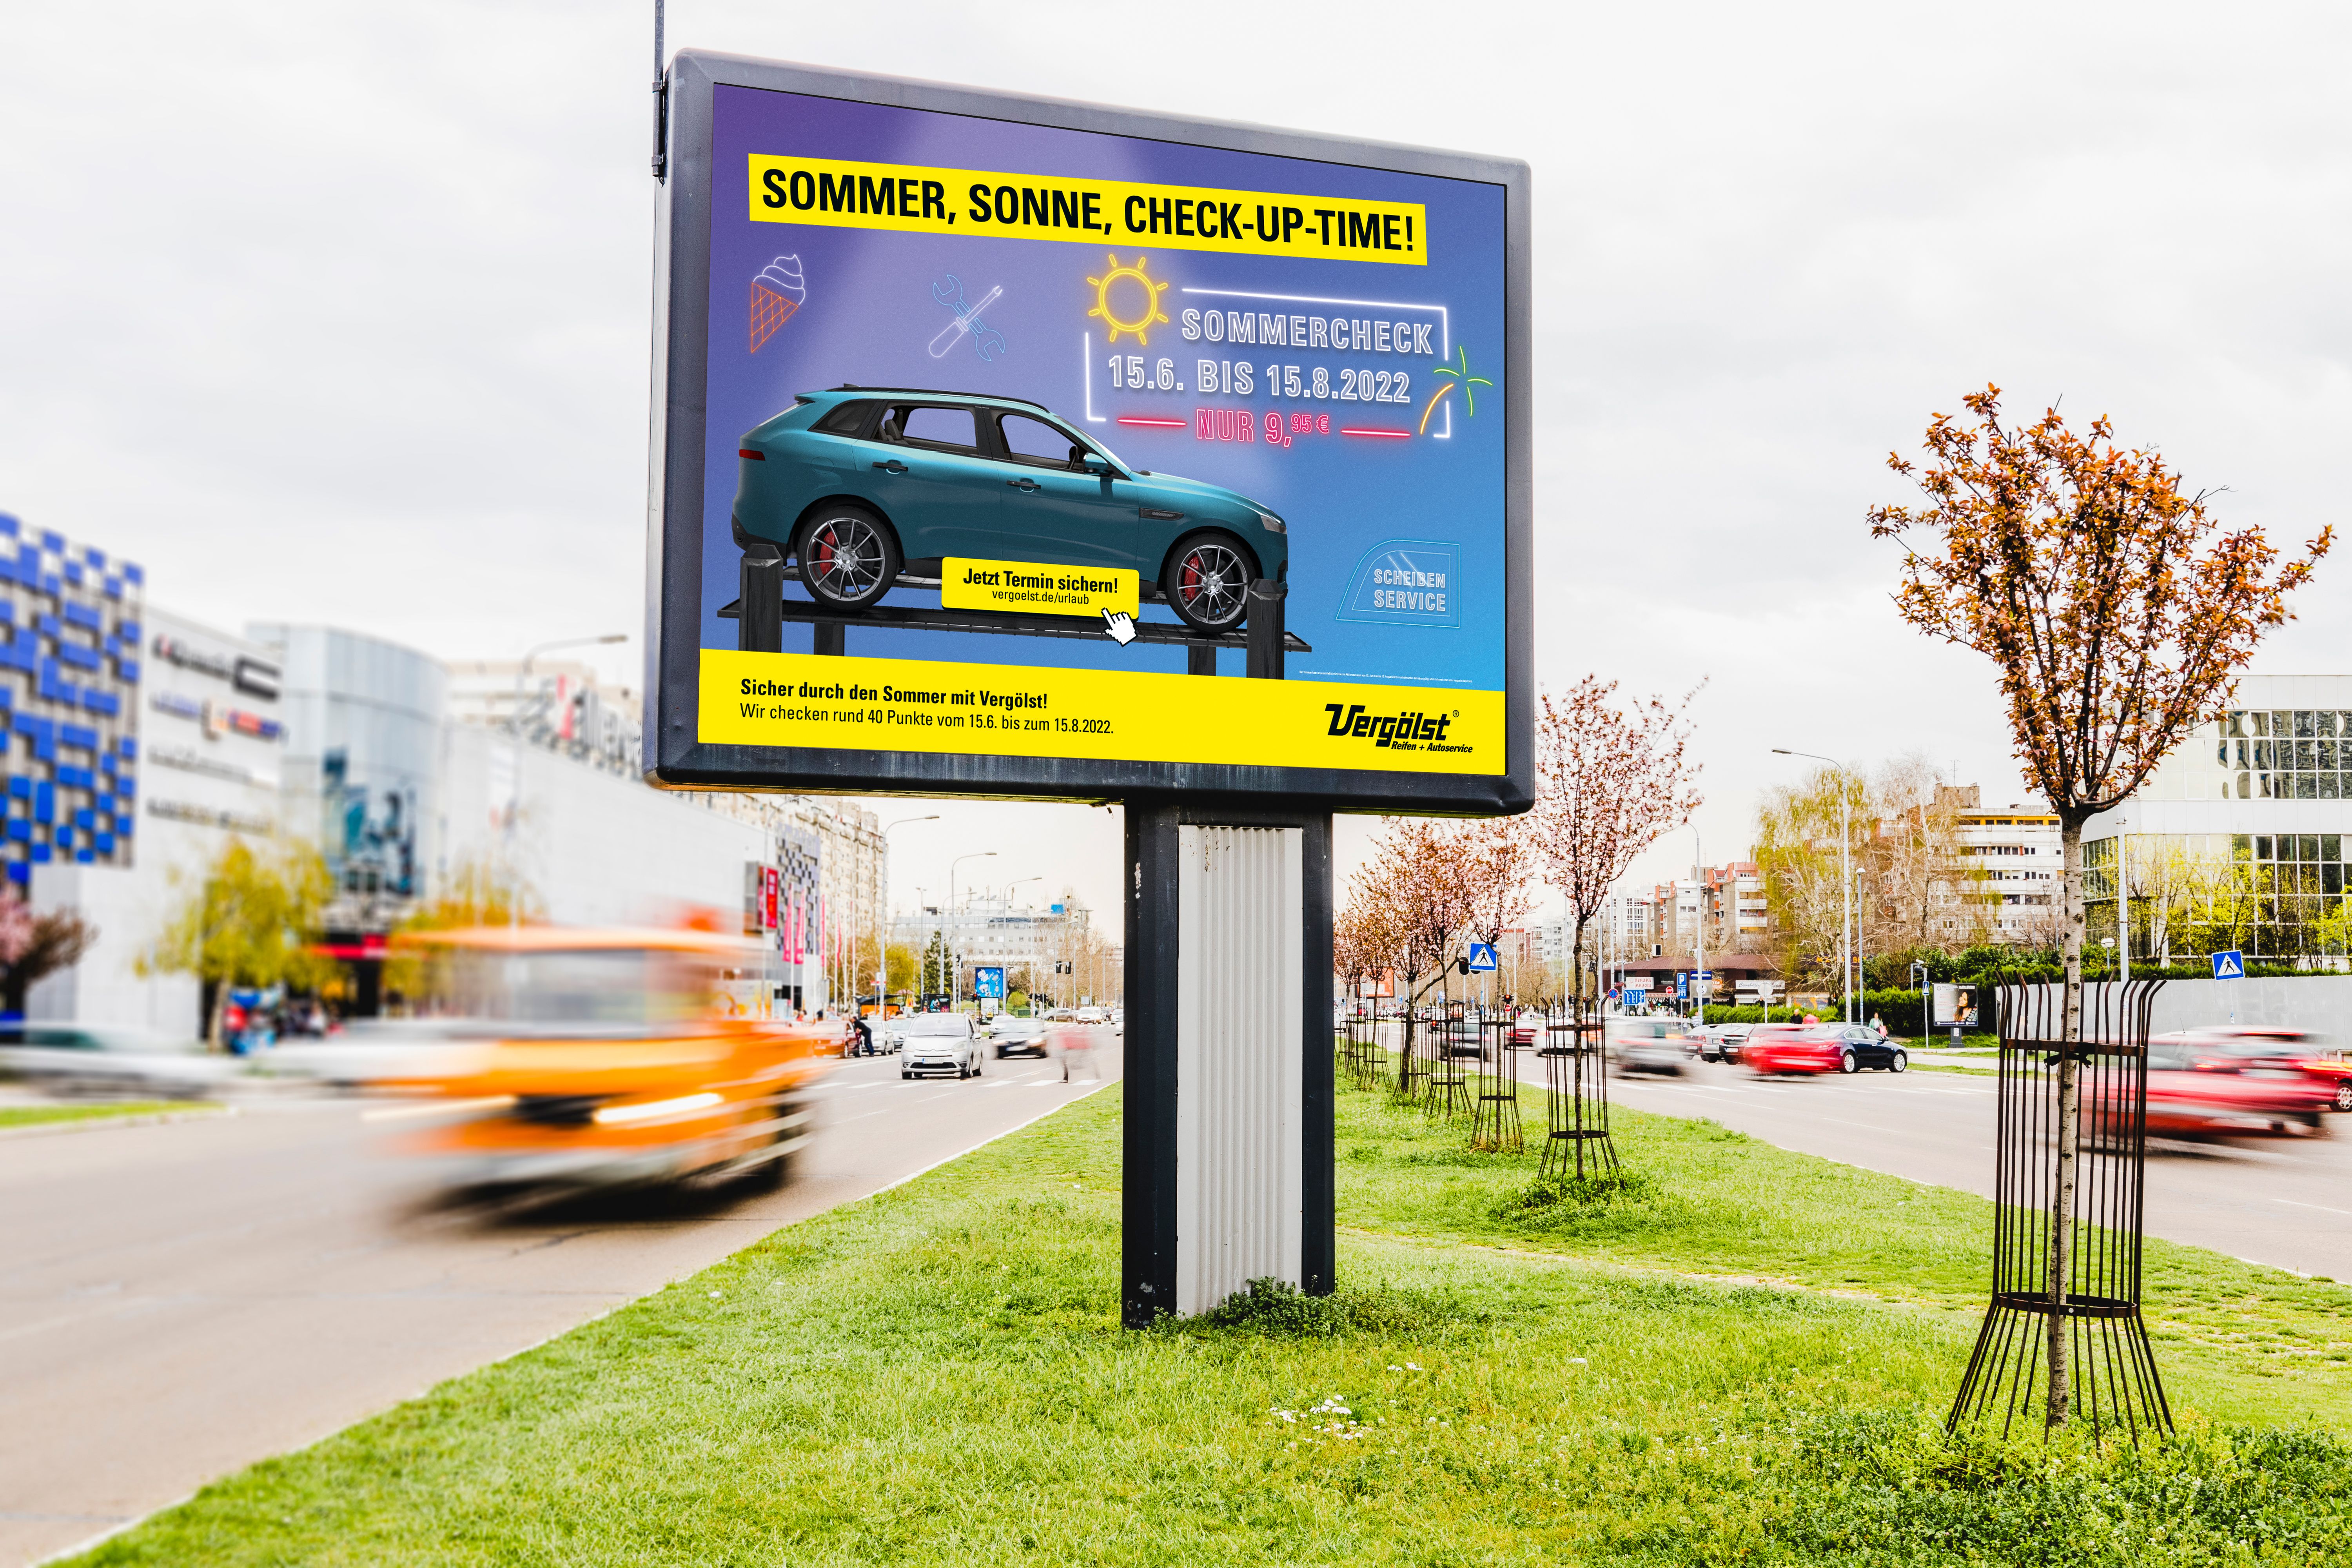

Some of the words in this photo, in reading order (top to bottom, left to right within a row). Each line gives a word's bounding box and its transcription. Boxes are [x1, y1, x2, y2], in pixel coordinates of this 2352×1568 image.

[763, 169, 956, 225] SOMMER,
[969, 184, 1112, 235] SONNE,
[1125, 195, 1413, 251] CHECK-UP-TIME!
[1181, 308, 1434, 354] SOMMERCHECK
[1108, 355, 1184, 391] 15.6.
[1198, 359, 1254, 395] BIS
[1266, 364, 1411, 403] 15.8.2022
[1196, 409, 1254, 442] NUR
[963, 568, 1000, 586] Jetzt
[1003, 570, 1053, 589] Termin
[1058, 575, 1118, 593] sichern!
[1374, 569, 1446, 588] SCHEIBEN
[992, 590, 1089, 604] vergoelst.de/urlaub
[1374, 590, 1446, 611] SERVICE
[741, 678, 794, 697] Sicher
[799, 682, 844, 699] durch
[849, 684, 877, 701] den
[883, 685, 947, 704] Sommer
[951, 690, 975, 706] mit
[979, 690, 1047, 711] Vergölst!
[740, 703, 766, 718] Wir
[770, 705, 828, 721] checken
[833, 708, 863, 723] rund
[867, 710, 883, 724] 40
[887, 710, 933, 726] Punkte
[937, 716, 964, 727] vom
[969, 714, 997, 729] 15.6.
[1002, 715, 1020, 730] bis
[1024, 720, 1049, 731] zum
[1055, 718, 1114, 734] 15.8.2022.
[1325, 703, 1451, 747] Vergölst
[1391, 741, 1417, 750] Reifen
[1426, 742, 1473, 753] Autoservice
